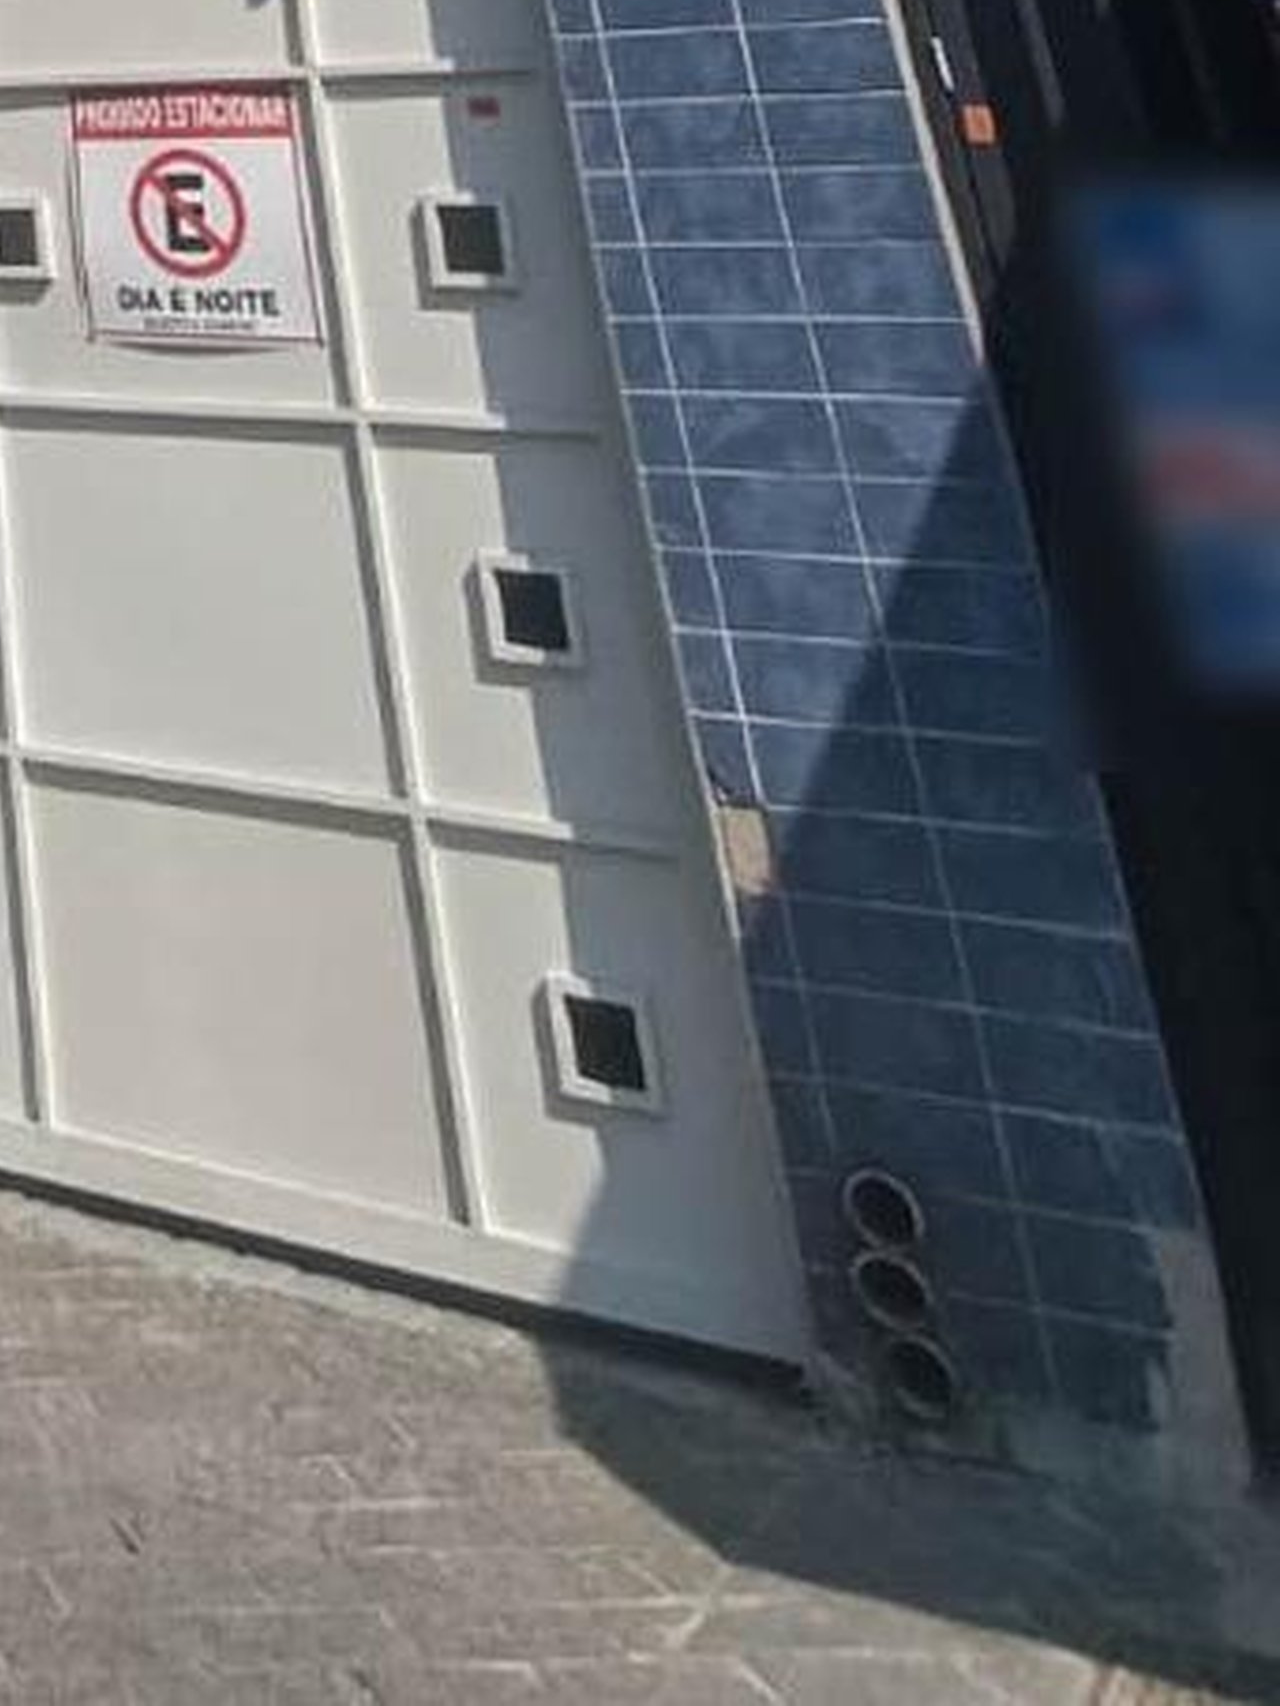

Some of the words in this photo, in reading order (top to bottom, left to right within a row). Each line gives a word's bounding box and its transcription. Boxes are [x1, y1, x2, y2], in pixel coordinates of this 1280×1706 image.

[118, 286, 162, 312] DIA
[170, 289, 186, 313] E
[195, 289, 280, 317] NOITE
